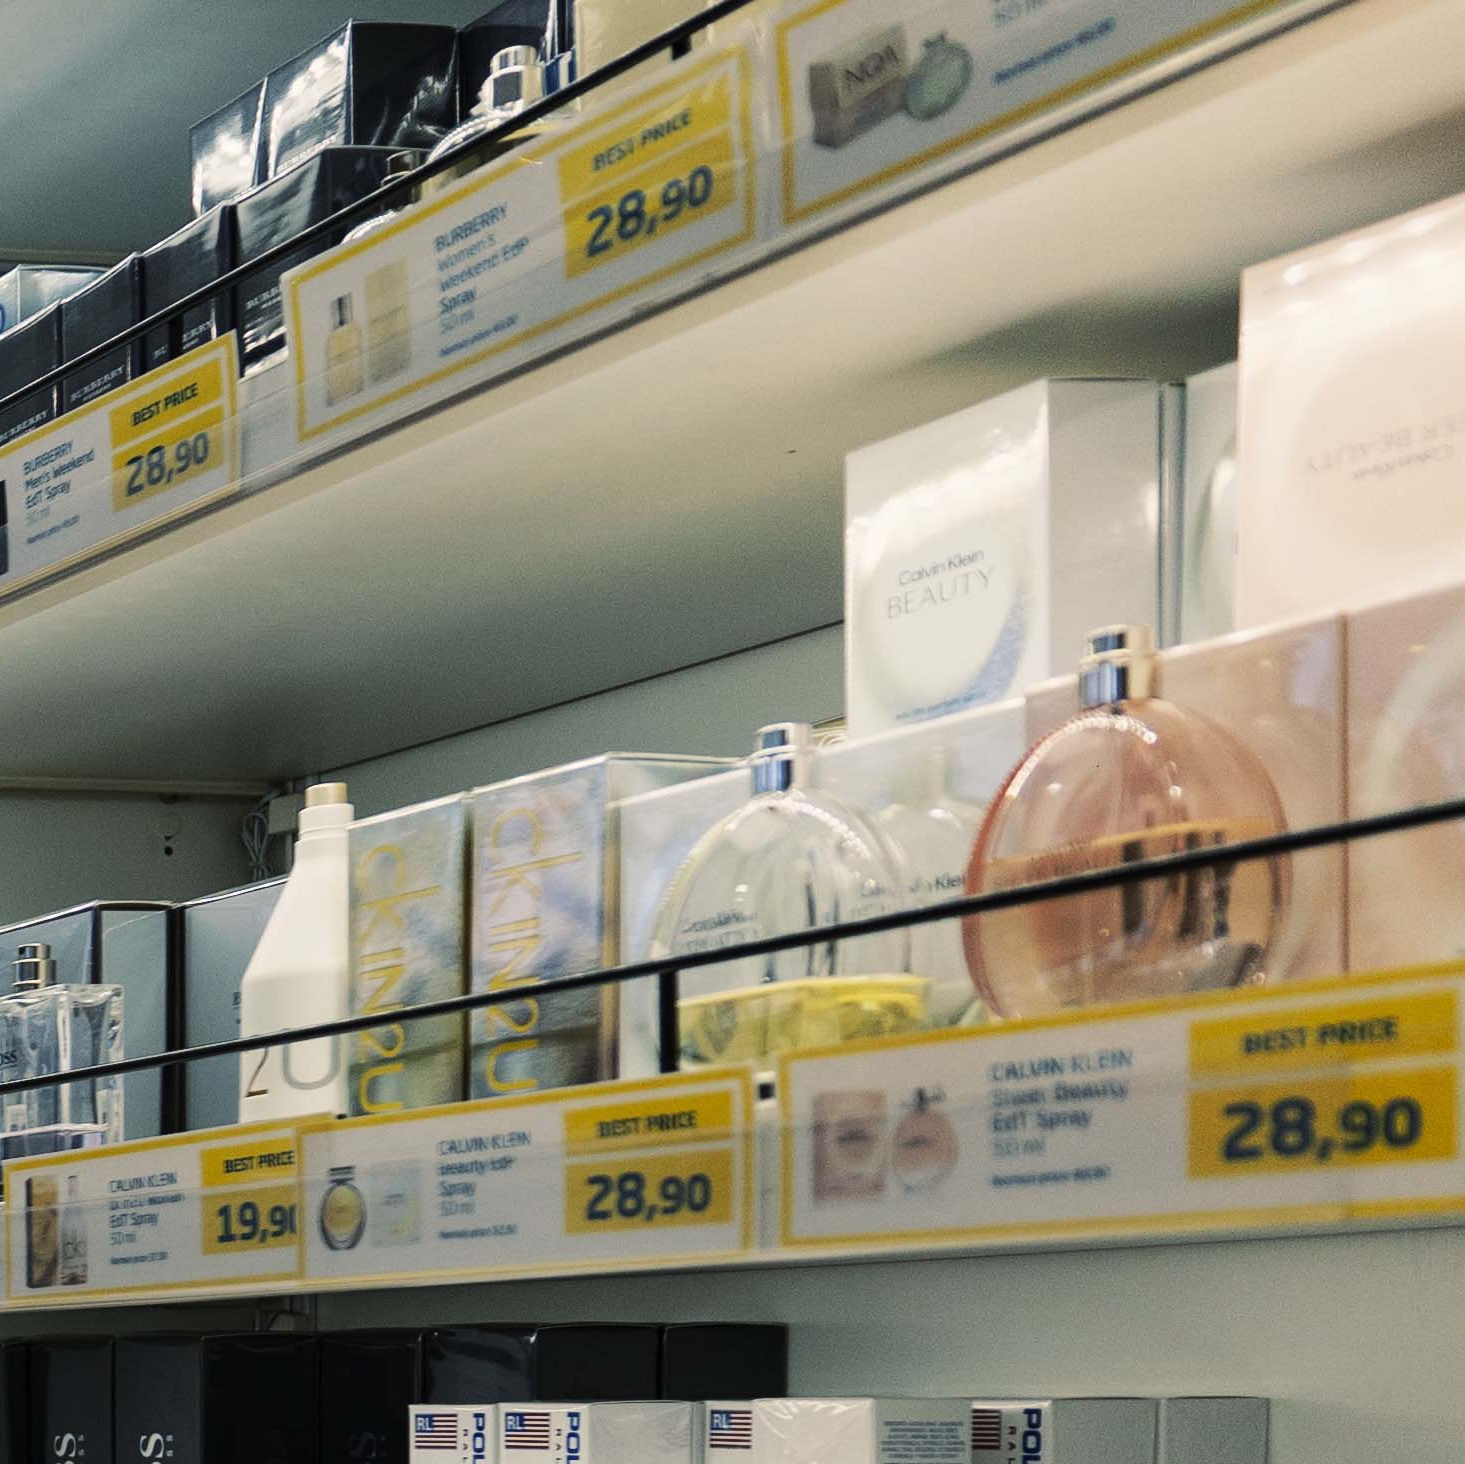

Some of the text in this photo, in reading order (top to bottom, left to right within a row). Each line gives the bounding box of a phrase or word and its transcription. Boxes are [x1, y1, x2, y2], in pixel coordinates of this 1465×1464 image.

[591, 107, 693, 173] BEST PRICE
[435, 203, 507, 252] BURBERRY
[586, 164, 714, 259] 28,90
[132, 383, 198, 426] BEST PRICE
[23, 440, 74, 476] BURBERRY
[126, 431, 210, 498] 28,90
[26, 480, 71, 510] EdT Spray
[898, 548, 985, 589] Calvin Klein
[886, 566, 996, 620] BEAUTY
[1242, 1015, 1400, 1056] BEST PRICE
[989, 1049, 1134, 1083] CALVIN KLEIN
[438, 1129, 532, 1155] CALVIN KLEIN
[597, 1110, 698, 1139] BEST PRICE
[1220, 1094, 1423, 1165] 28,90
[223, 1150, 296, 1174] BEST PRICE
[109, 1176, 146, 1193] CALVIN
[585, 1171, 714, 1222] 28,90
[110, 1210, 159, 1229] EdT Spray
[415, 1417, 434, 1432] RL
[506, 1415, 524, 1431] RL
[711, 1413, 730, 1429] RL
